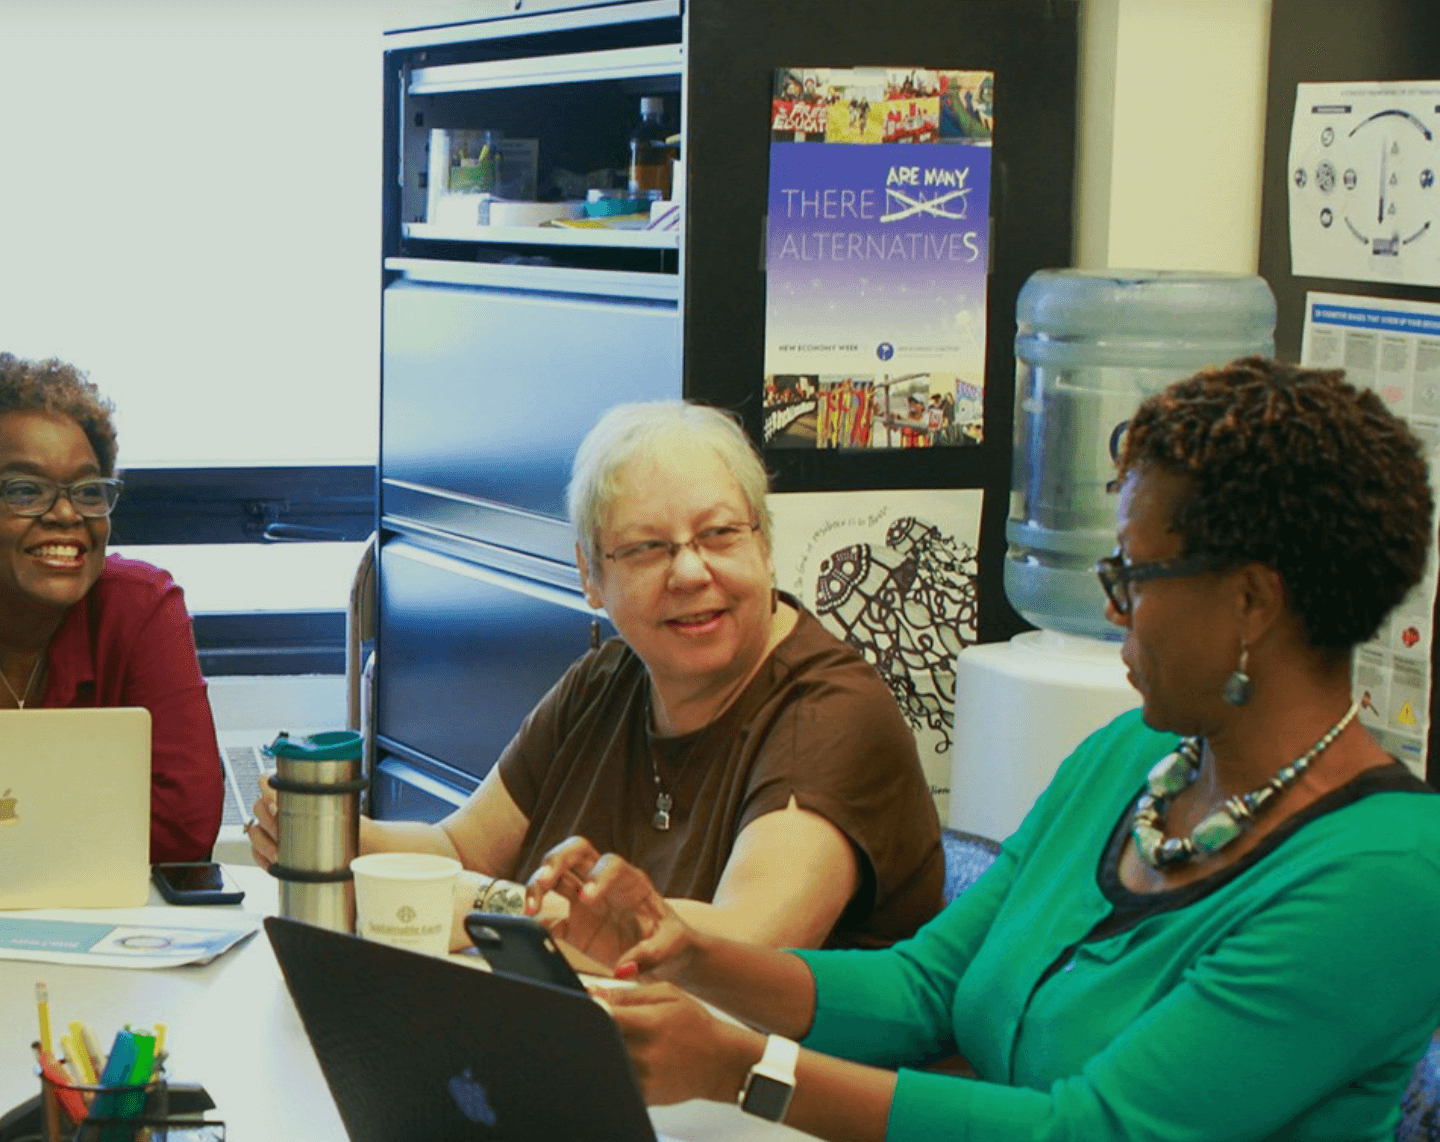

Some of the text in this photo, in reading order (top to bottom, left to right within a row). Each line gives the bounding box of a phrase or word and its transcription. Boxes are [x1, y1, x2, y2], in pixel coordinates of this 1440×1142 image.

[886, 167, 969, 188] ARE MANY
[781, 189, 874, 219] THERE
[779, 232, 979, 262] ALTERNATIVES
